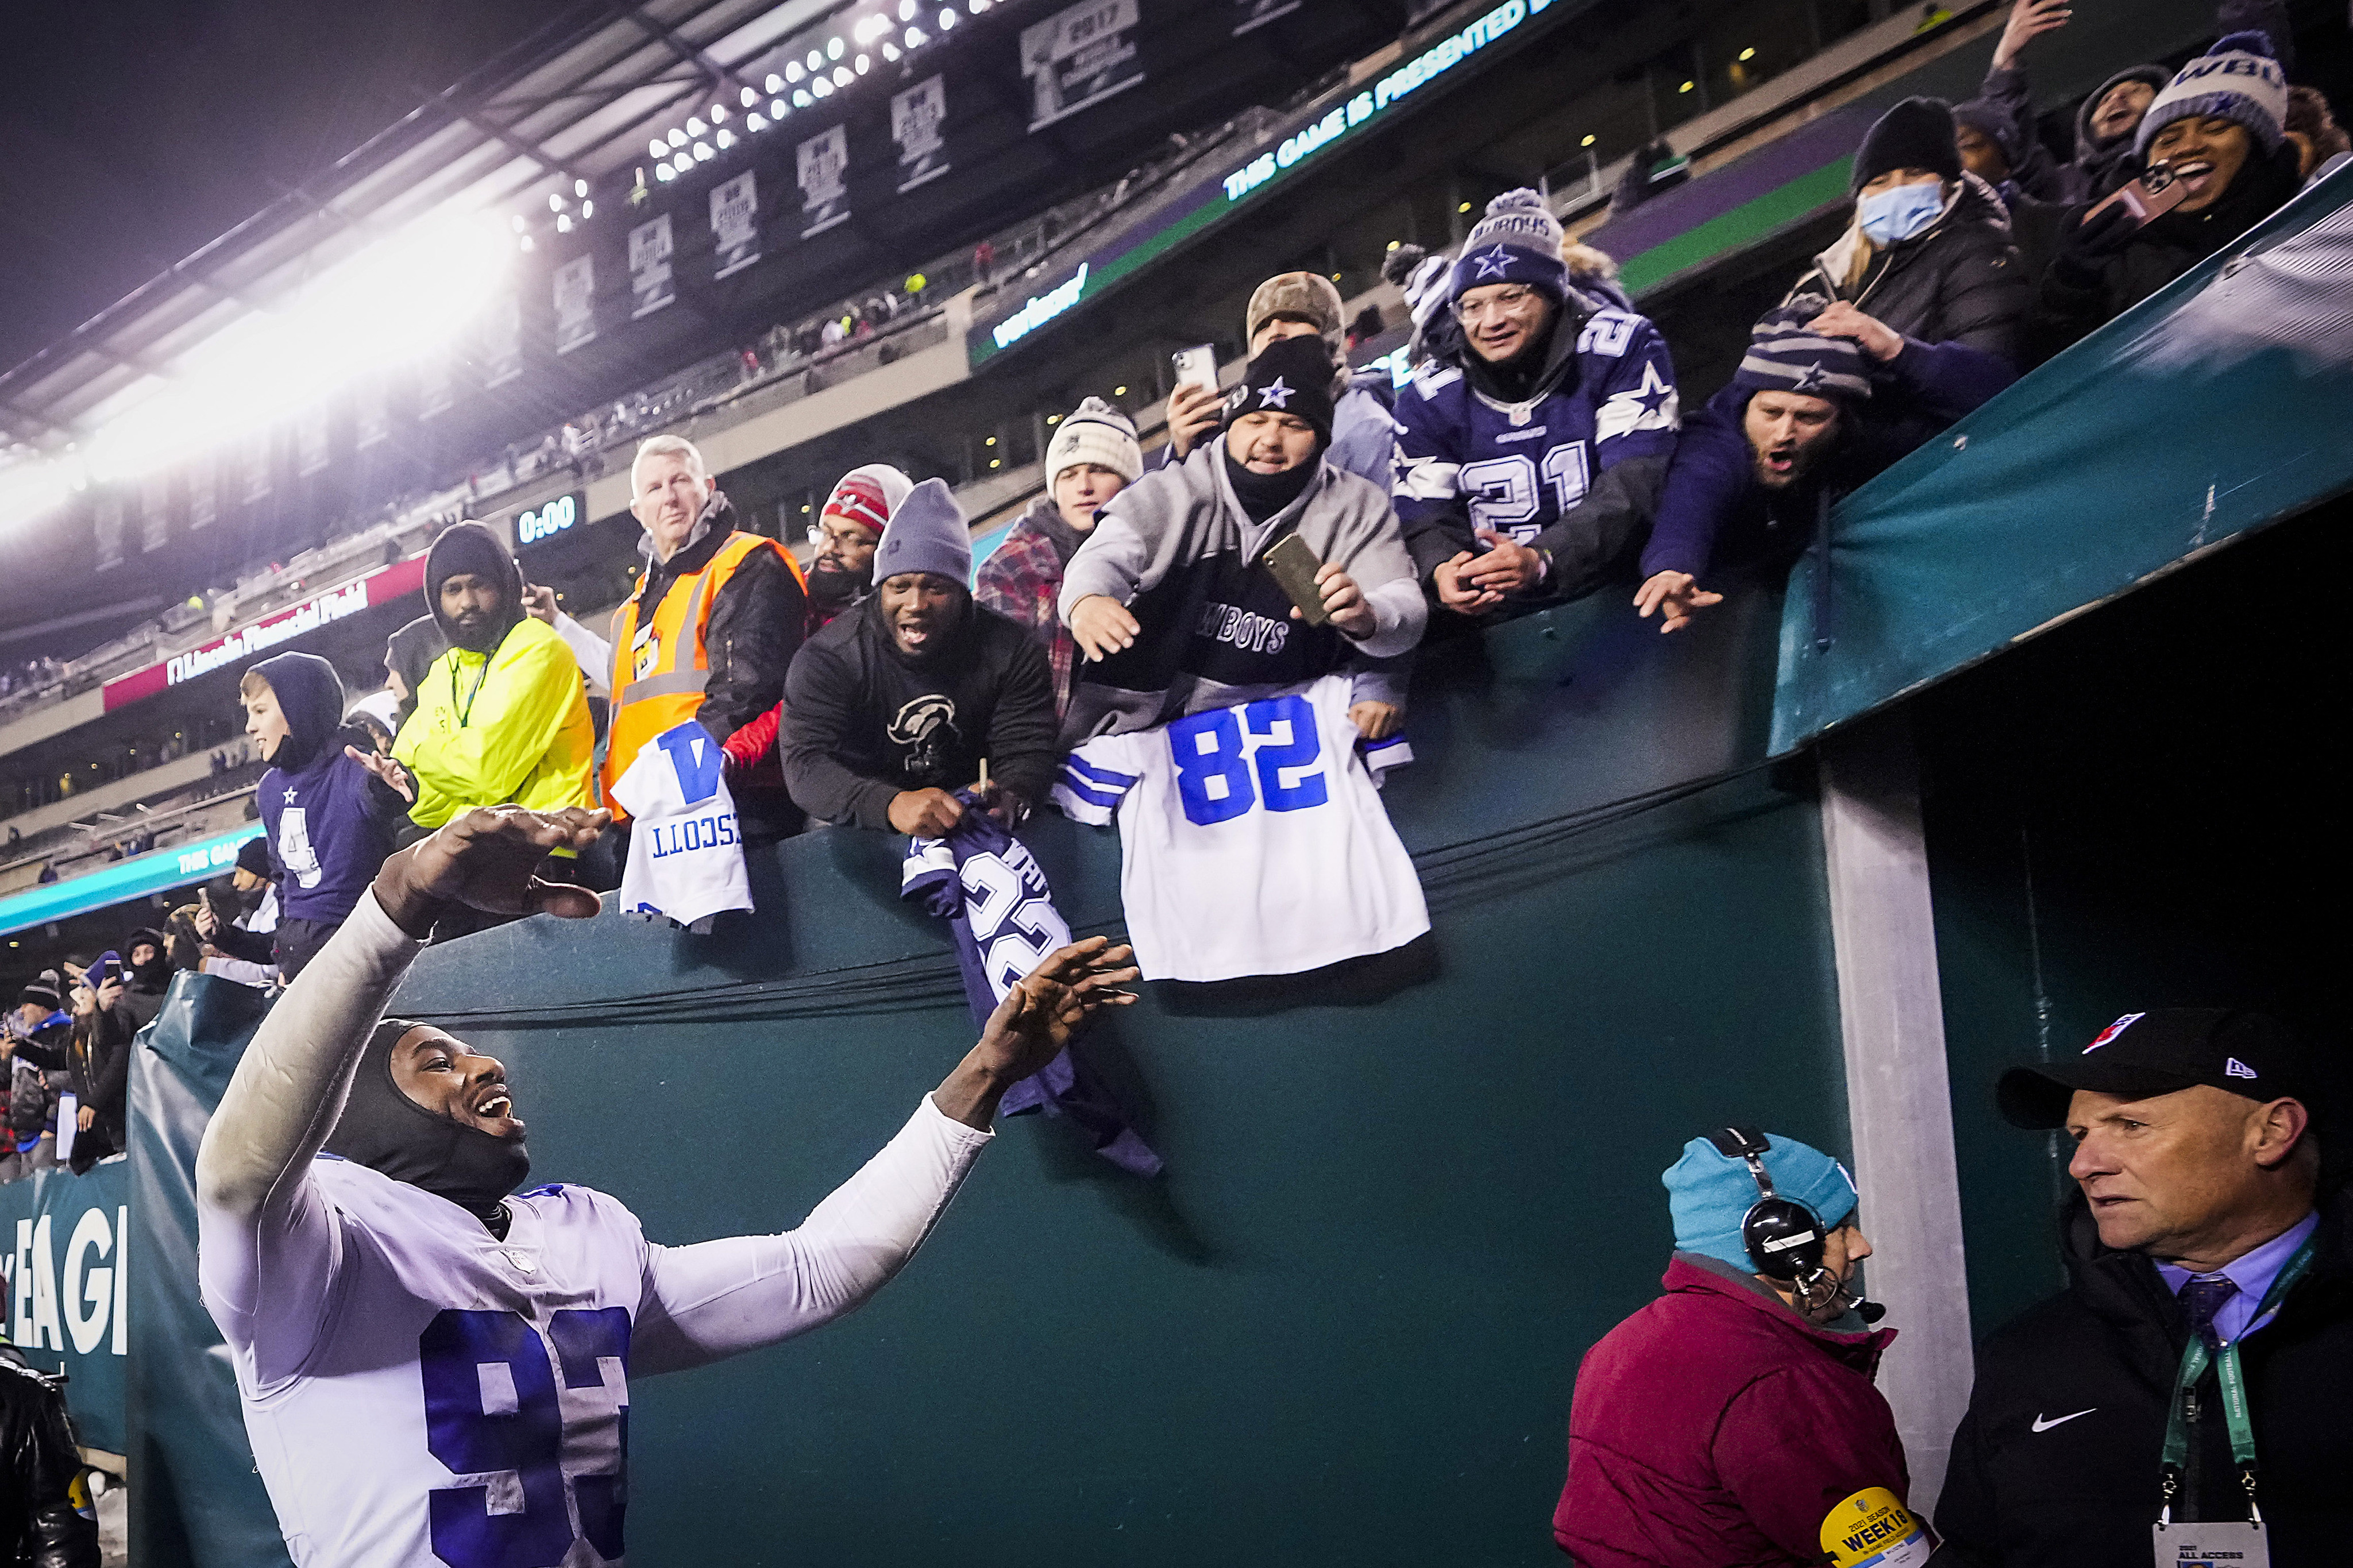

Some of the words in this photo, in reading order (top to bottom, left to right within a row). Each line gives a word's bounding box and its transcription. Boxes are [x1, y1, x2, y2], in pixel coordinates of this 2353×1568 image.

[1222, 152, 1276, 202] THIS
[1276, 107, 1346, 169] GAME
[1346, 91, 1374, 128] IS
[1374, 0, 1527, 110] PRESENTED
[519, 496, 575, 543] 0:00
[1457, 439, 1591, 553] 21
[1167, 693, 1331, 827] 82
[277, 806, 322, 889] 4
[653, 812, 742, 859] SCOTT
[1849, 1519, 1868, 1532] 2021
[1867, 1506, 1891, 1522] SEASON
